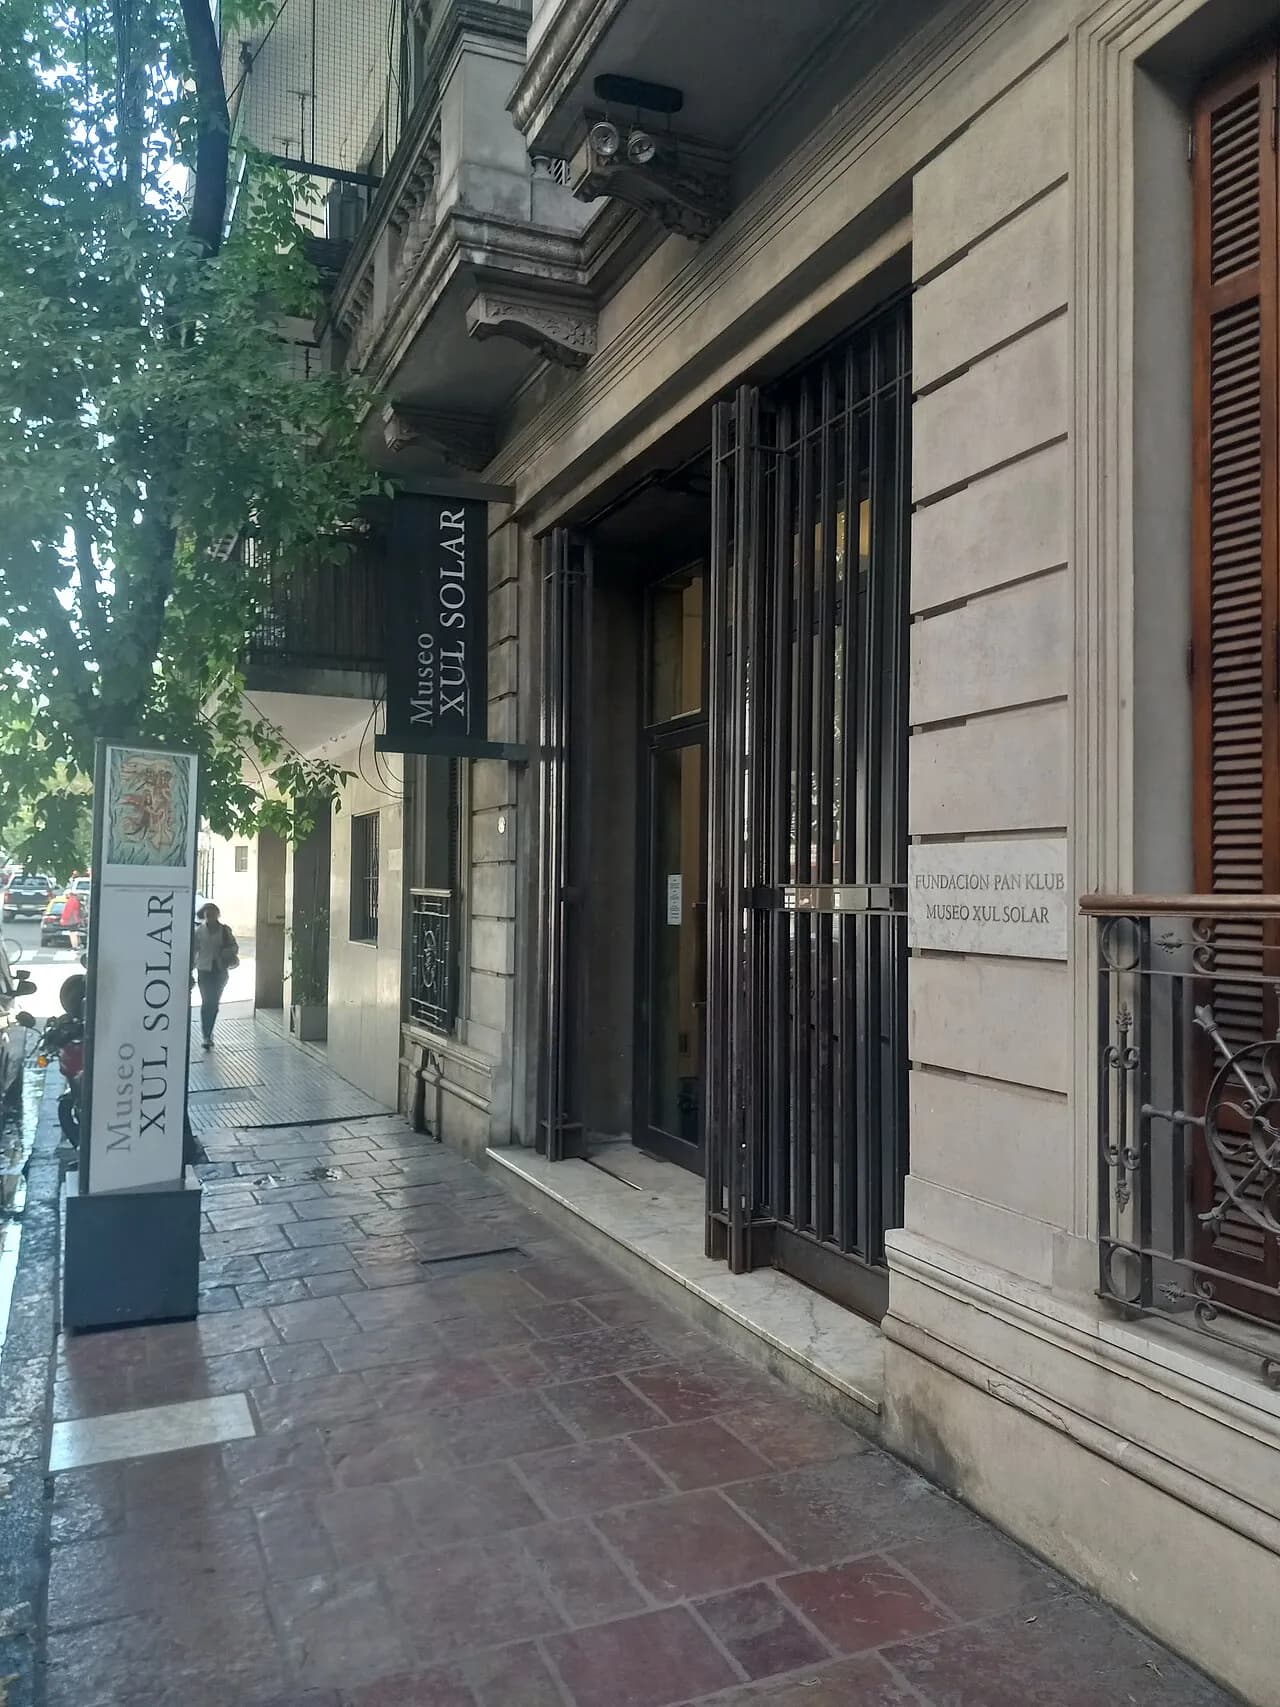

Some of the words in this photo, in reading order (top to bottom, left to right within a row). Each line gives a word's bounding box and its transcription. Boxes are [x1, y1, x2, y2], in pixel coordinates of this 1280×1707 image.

[439, 507, 466, 629] SOLAR
[410, 633, 434, 727] Museo
[439, 640, 466, 717] XUL
[914, 873, 990, 890] FUNDACION
[994, 873, 1022, 890] PAN
[1024, 872, 1065, 890] KLUB
[926, 903, 970, 921] MUSEO
[972, 905, 1000, 922] XUL
[1002, 906, 1050, 924] SOLAR
[142, 891, 175, 1032] SOLAR
[105, 1042, 136, 1154] Museo
[138, 1045, 169, 1138] XUL
